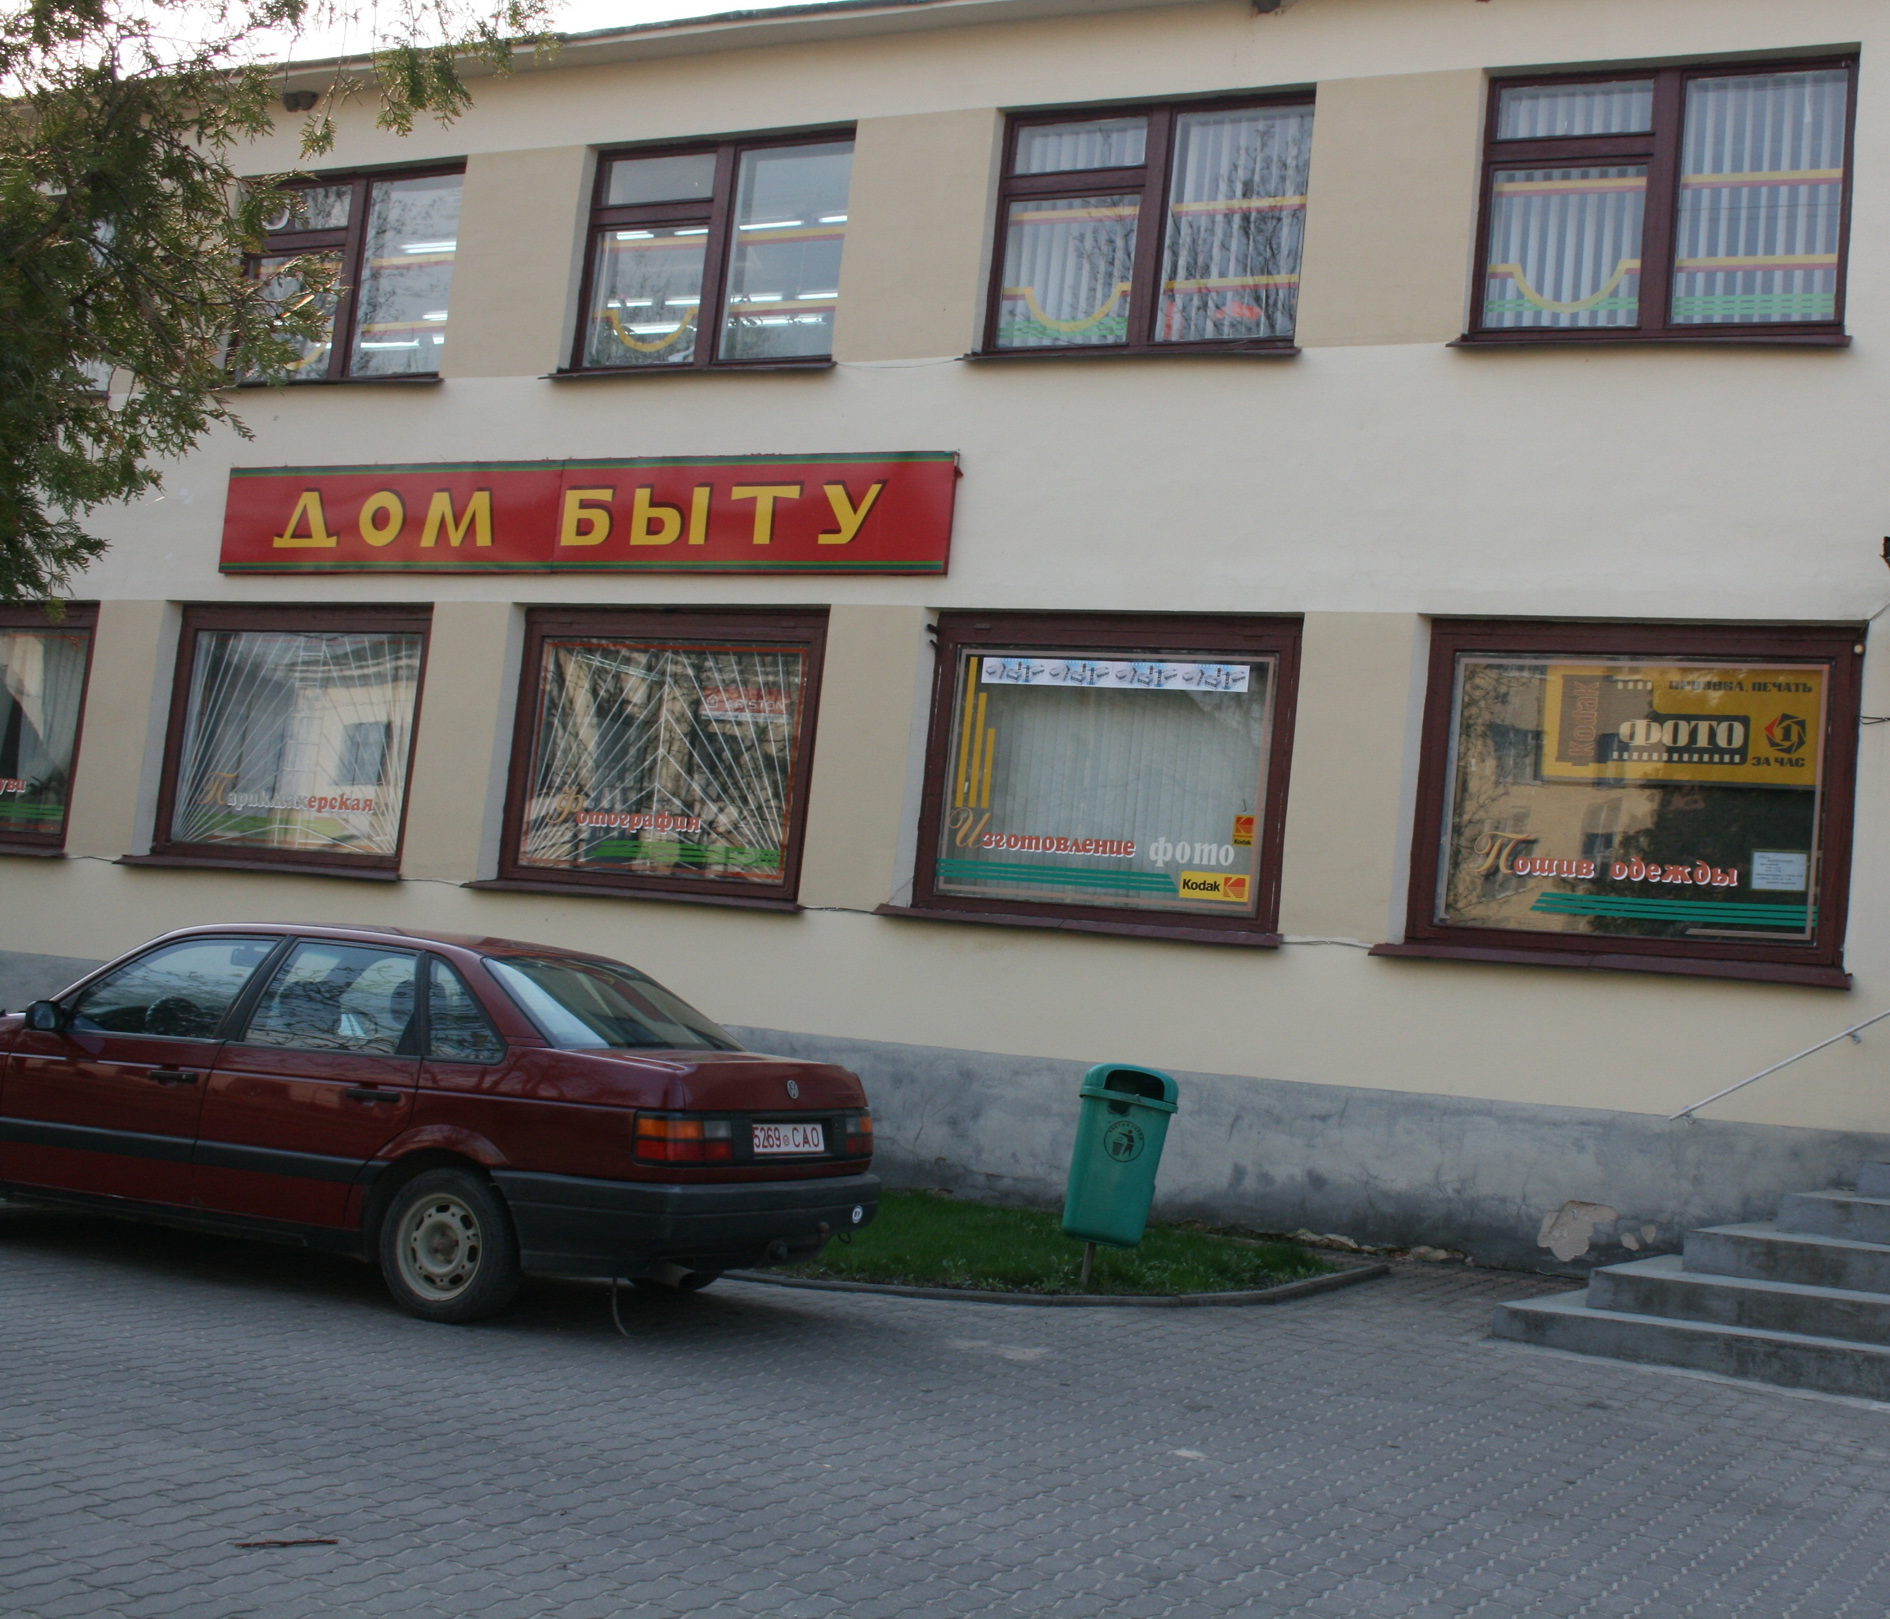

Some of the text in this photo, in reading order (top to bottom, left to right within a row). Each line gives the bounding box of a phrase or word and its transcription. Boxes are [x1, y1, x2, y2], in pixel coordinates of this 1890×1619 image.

[273, 483, 884, 548] ДОМ БЫТУ
[1752, 681, 1813, 693] ПЕЧАТЬ
[1569, 681, 1600, 757] Kodak
[1618, 718, 1745, 749] ФОТО
[1780, 723, 1793, 742] 1
[1751, 756, 1806, 768] ЗА ЧАС
[547, 784, 702, 834] Фотография
[950, 806, 1235, 867] Изготовление фото
[1468, 831, 1595, 879] Пошив
[1610, 855, 1739, 887] одежды
[1182, 878, 1221, 892] Kodak
[752, 1126, 782, 1148] 5269
